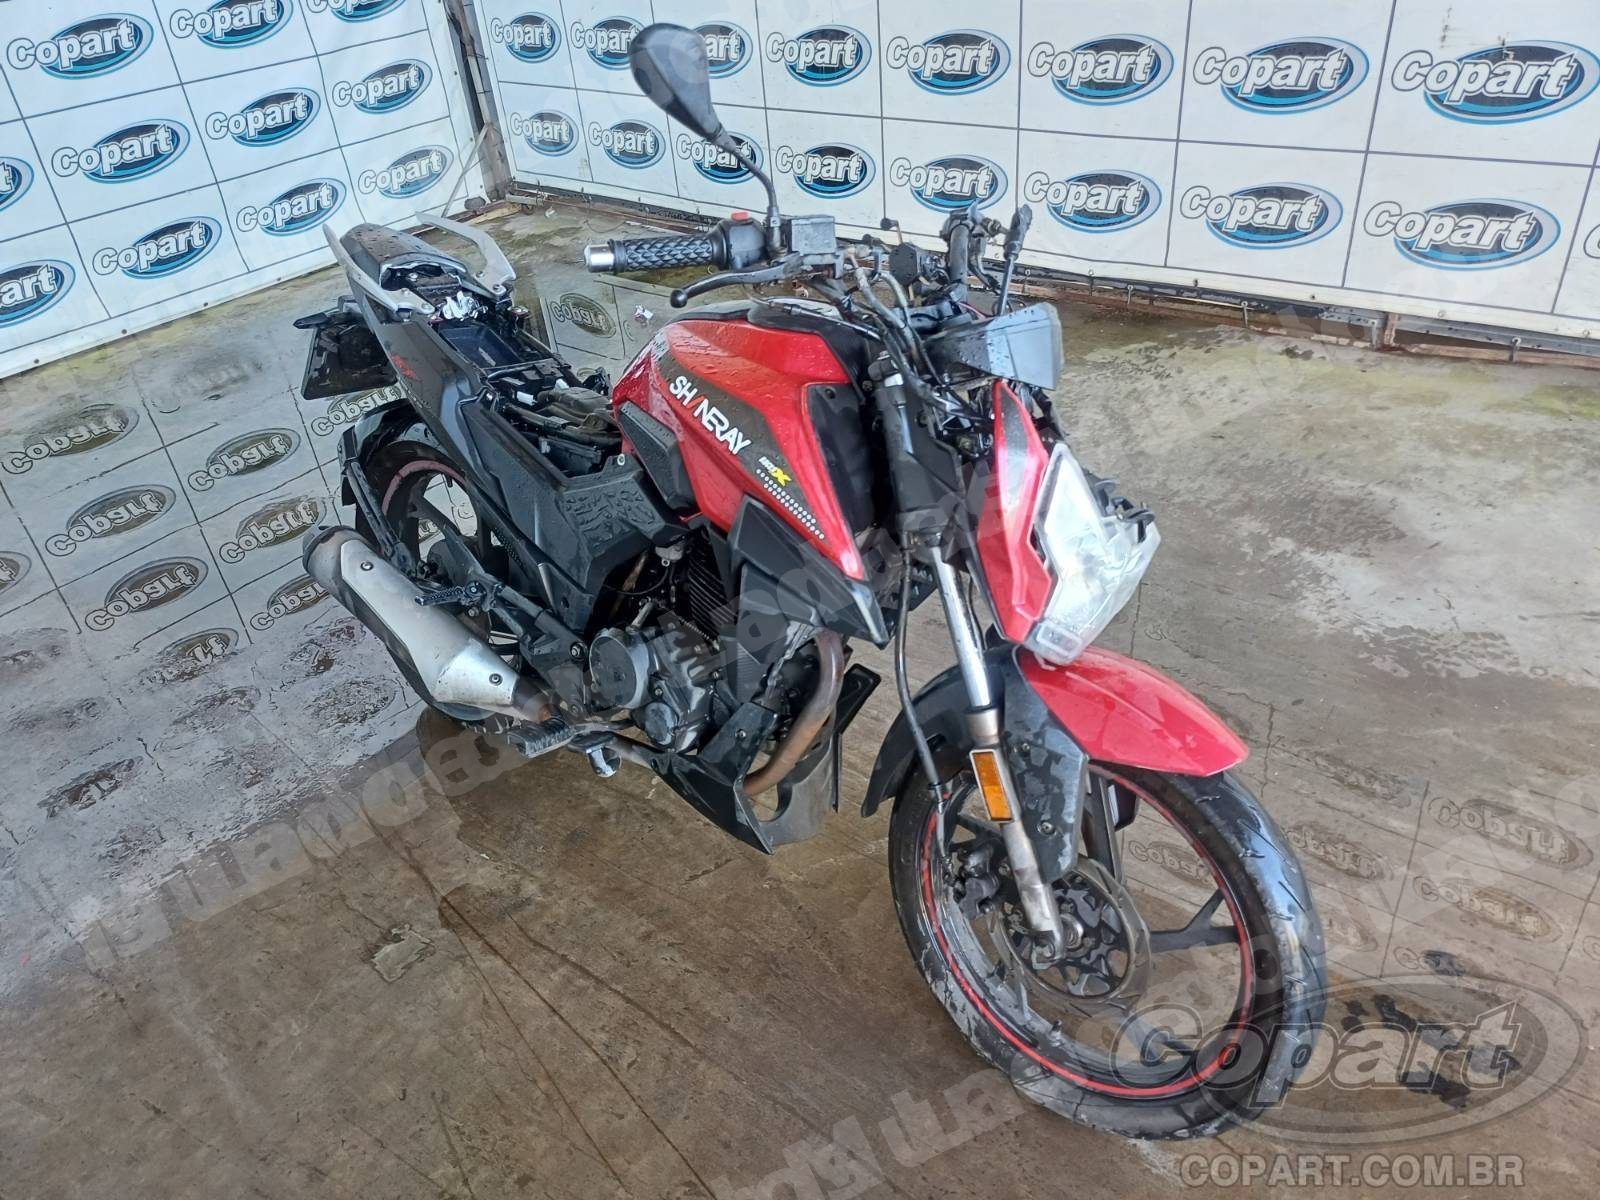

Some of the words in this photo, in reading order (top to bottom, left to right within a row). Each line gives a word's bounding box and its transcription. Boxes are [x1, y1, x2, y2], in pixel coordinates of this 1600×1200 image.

[170, 0, 278, 38] Copart
[490, 18, 552, 49] Copart
[7, 17, 137, 69] Copart
[703, 30, 740, 61] art
[765, 31, 856, 71] Copart
[886, 36, 995, 79] Copart
[1027, 42, 1154, 89] Copart
[332, 62, 421, 107] Copart
[1193, 46, 1344, 97] Copart
[1391, 49, 1577, 104] Copart
[205, 91, 309, 140] Copart
[510, 112, 571, 145] Copart
[51, 124, 174, 177] Copart
[588, 122, 655, 157] Copart
[357, 150, 443, 195] Copart
[775, 145, 864, 184] Copart
[890, 158, 993, 199] Copart
[237, 181, 332, 233] Copart
[1023, 171, 1144, 214] Copart
[1180, 186, 1321, 232] Copart
[93, 221, 207, 275] Copart
[1365, 201, 1537, 251] Copart
